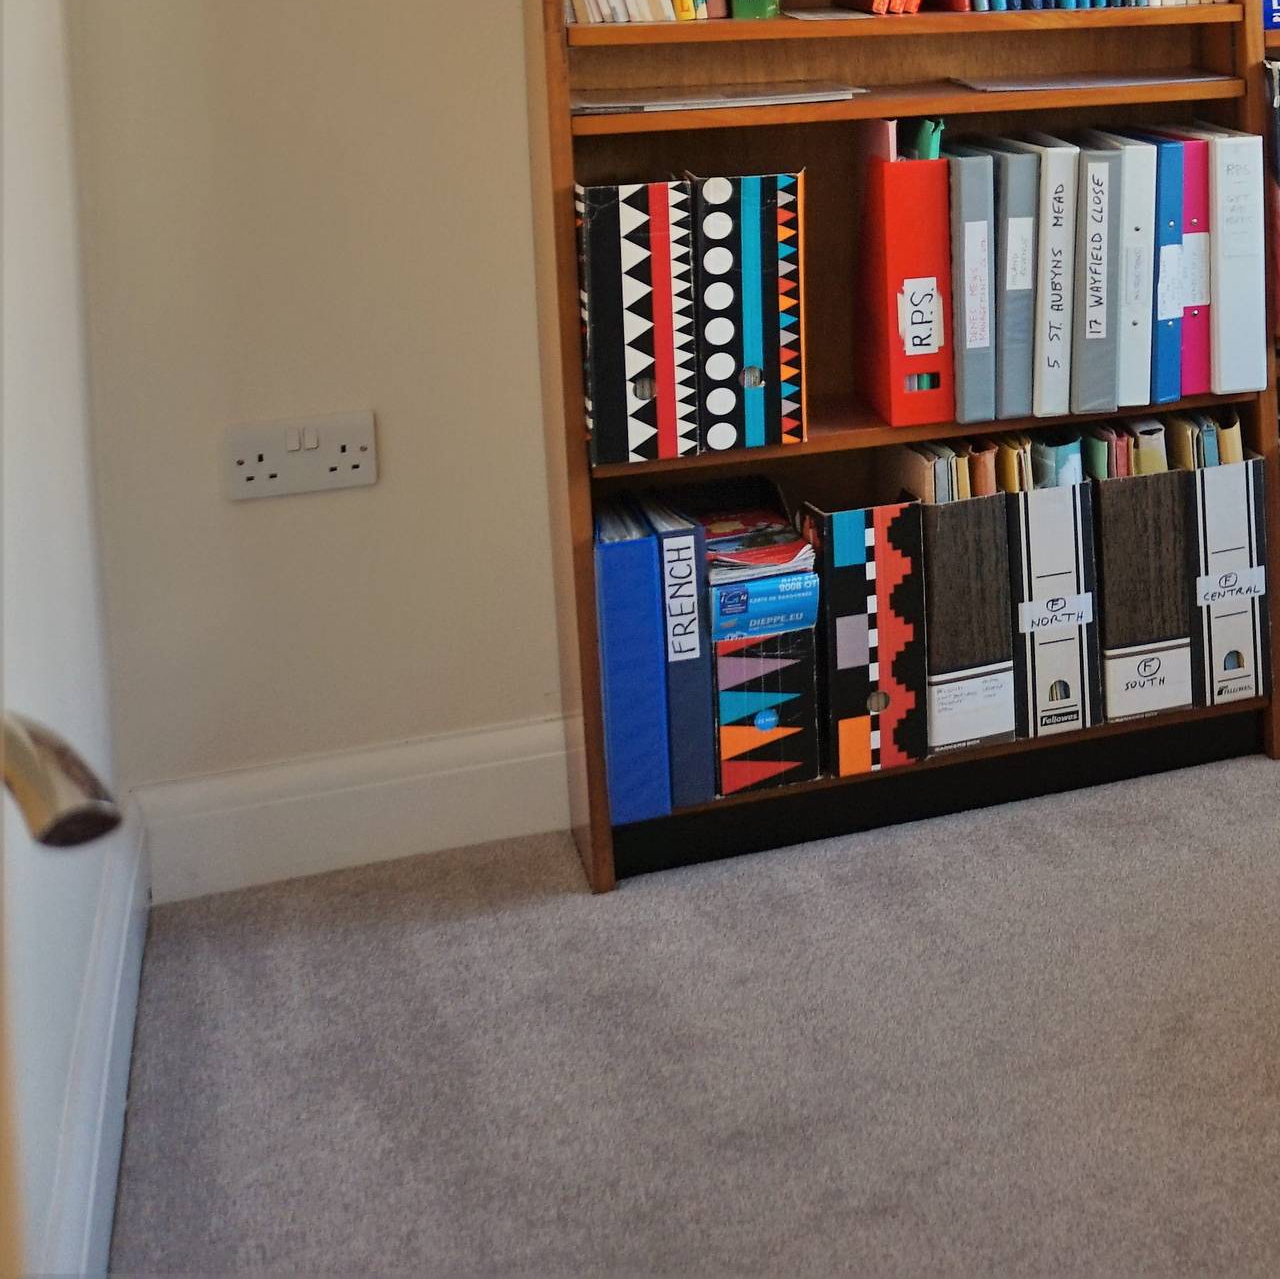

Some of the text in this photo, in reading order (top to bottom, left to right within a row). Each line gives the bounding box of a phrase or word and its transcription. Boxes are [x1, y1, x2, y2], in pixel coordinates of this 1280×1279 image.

[1047, 183, 1064, 369] 5 ST. AUBYNS MEAD
[1087, 176, 1105, 335] 17 WAYFIELD CLOSE
[911, 286, 935, 348] R.P.S.
[667, 546, 696, 654] FRENCH
[1030, 610, 1084, 629] NORTH
[1203, 585, 1262, 602] CENTRAL
[1124, 677, 1165, 691] SOUTH
